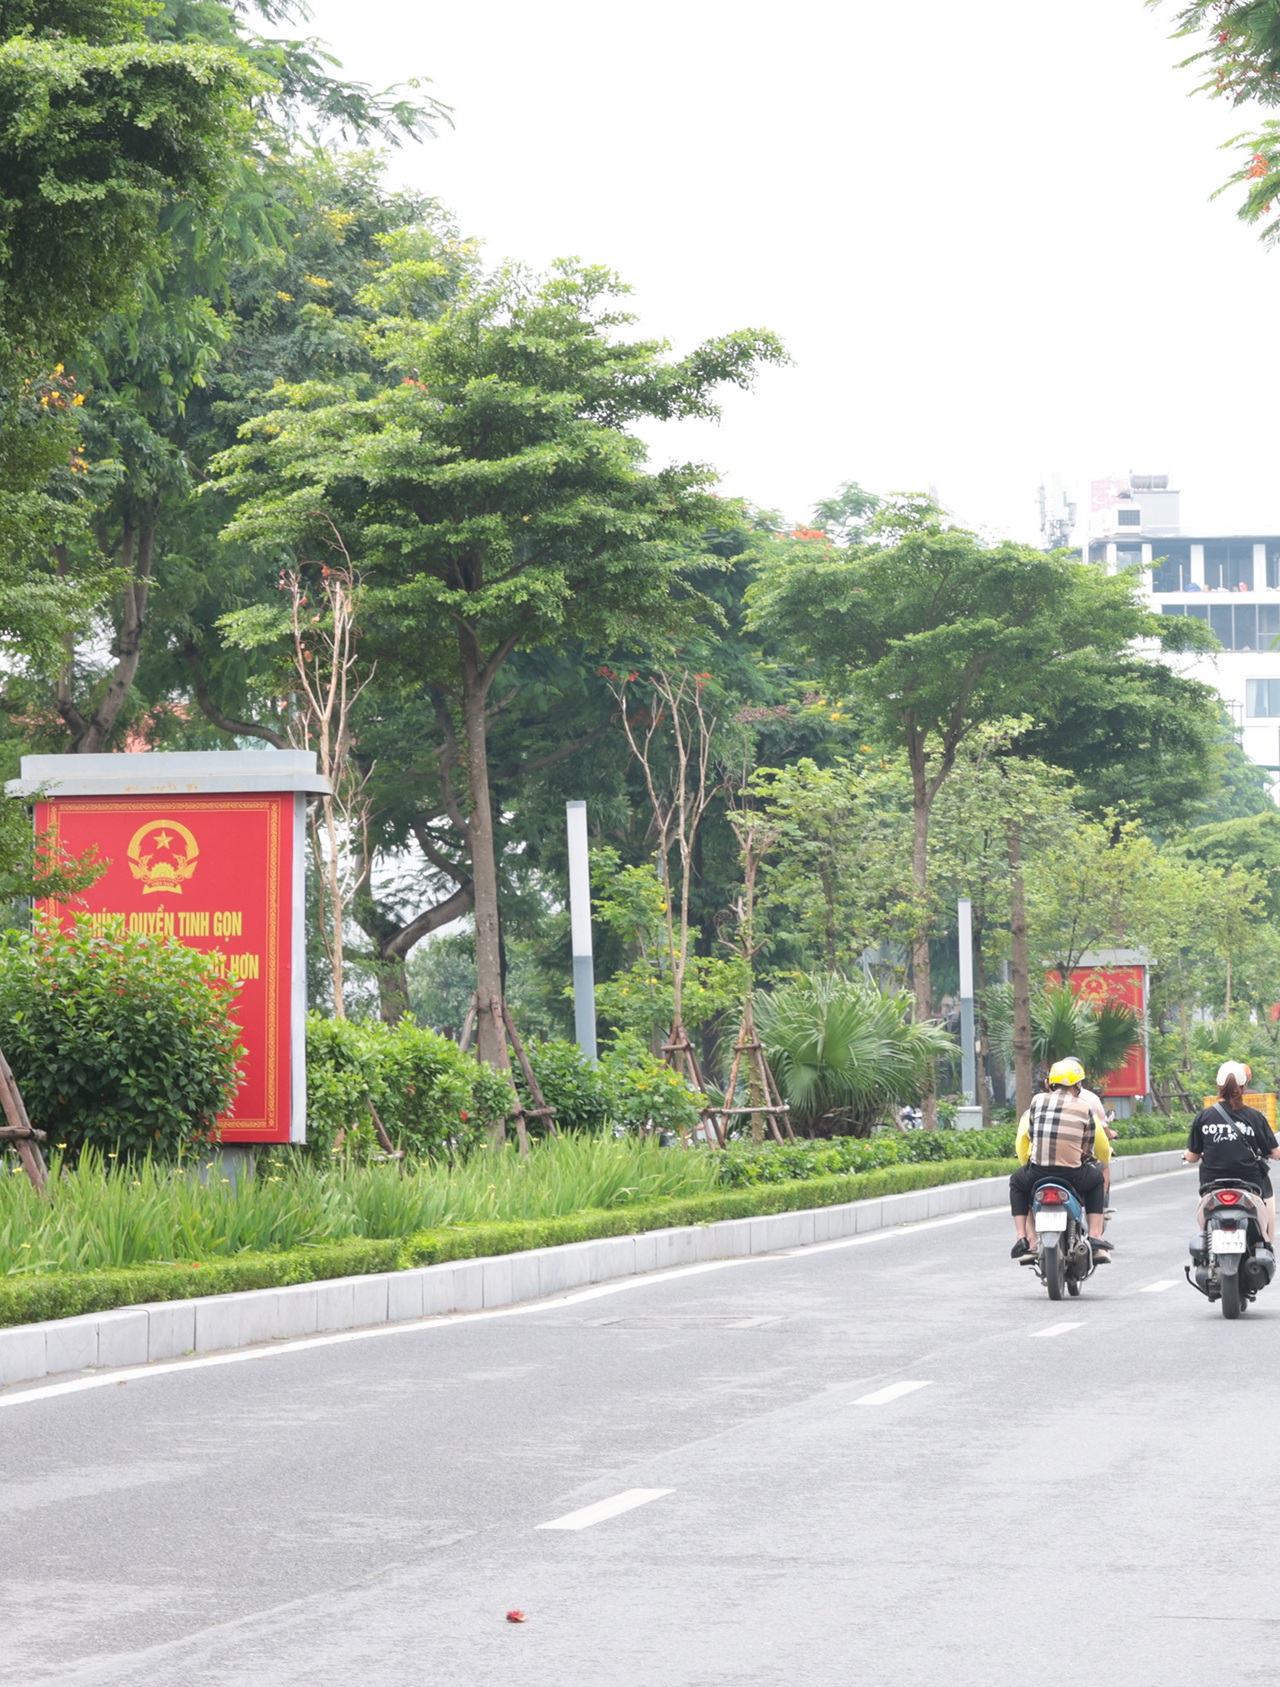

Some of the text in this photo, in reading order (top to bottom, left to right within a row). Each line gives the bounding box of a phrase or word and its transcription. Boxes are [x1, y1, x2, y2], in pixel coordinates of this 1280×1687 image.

[130, 904, 174, 936] QUYỀN
[178, 912, 209, 937] TINH
[213, 911, 242, 942] GỌN
